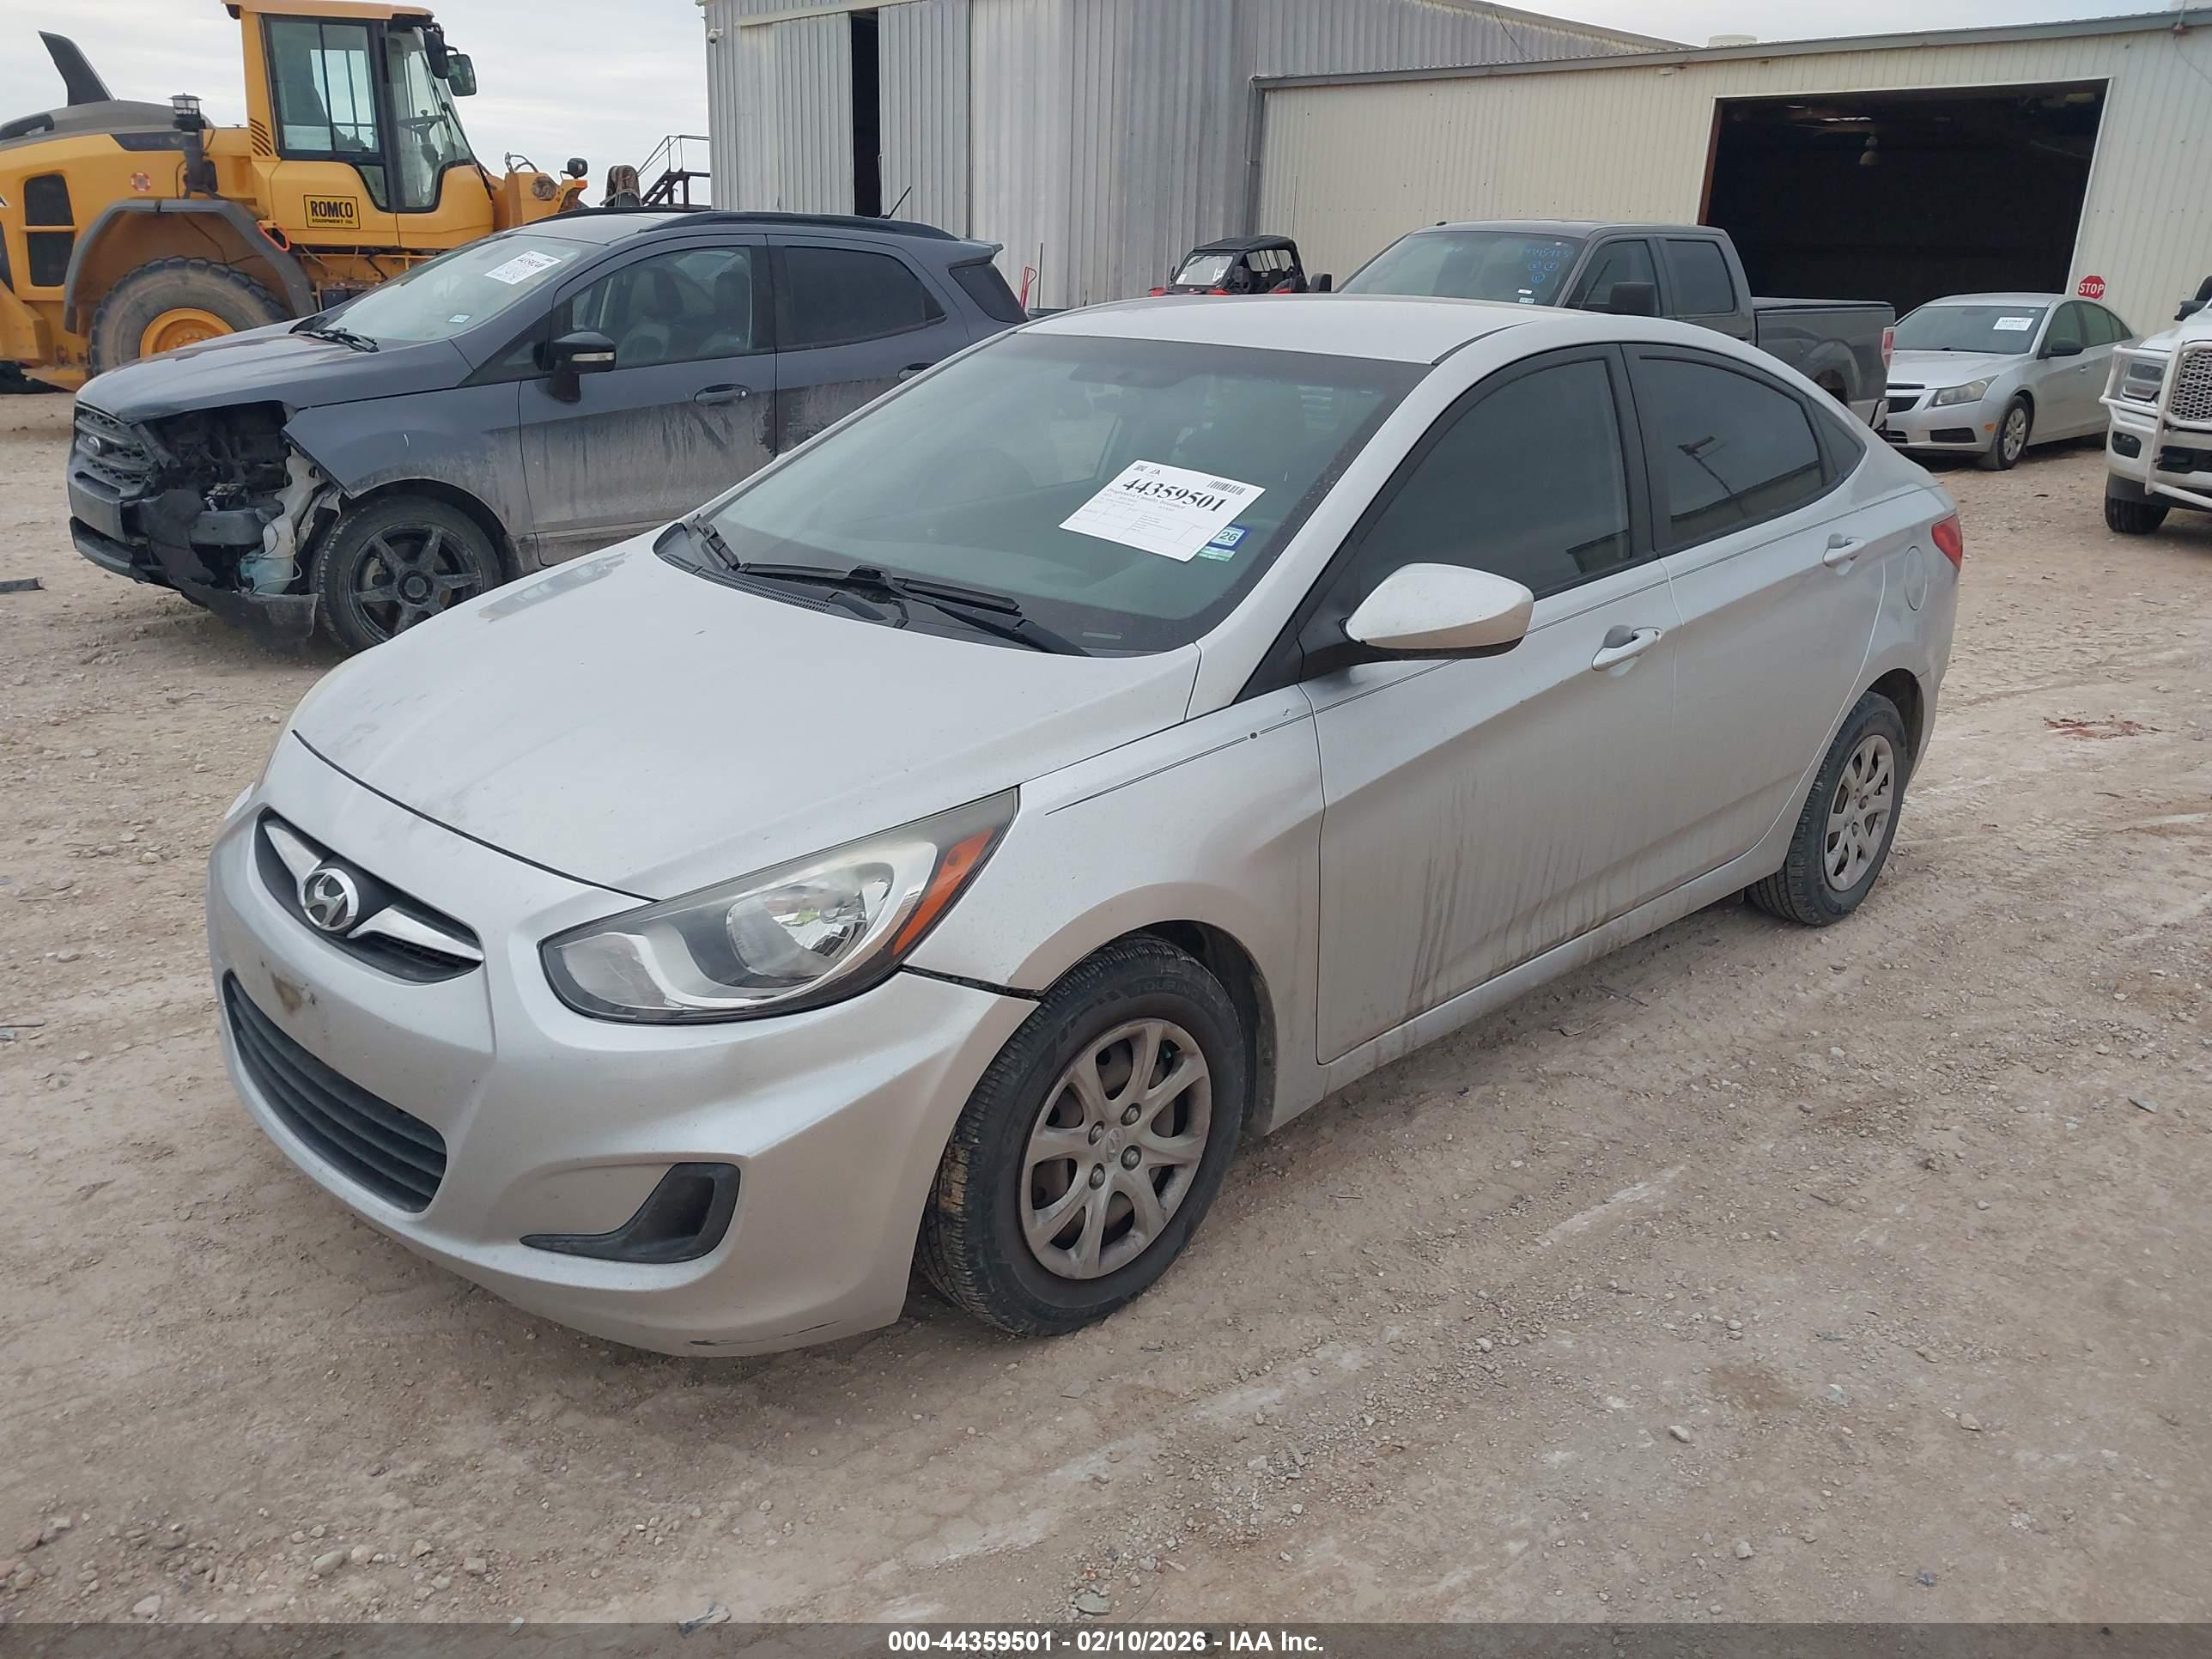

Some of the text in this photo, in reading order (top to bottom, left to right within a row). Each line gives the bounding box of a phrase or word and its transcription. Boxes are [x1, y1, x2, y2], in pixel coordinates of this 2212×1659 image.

[310, 200, 354, 218] ROMCO
[2079, 283, 2105, 295] STOP
[1122, 478, 1227, 513] 44359501
[1219, 531, 1239, 542] 26
